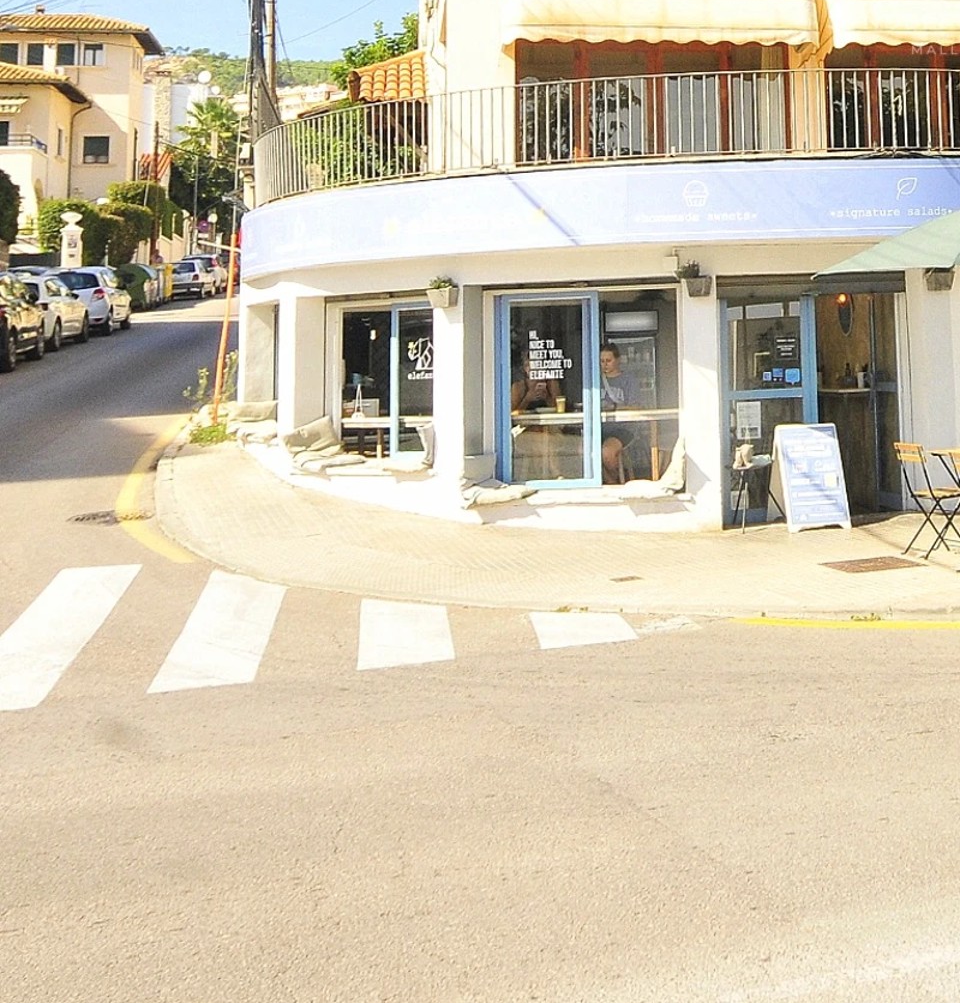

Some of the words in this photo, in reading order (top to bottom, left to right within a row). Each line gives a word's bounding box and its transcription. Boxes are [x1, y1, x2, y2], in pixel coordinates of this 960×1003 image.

[529, 340, 545, 350] NICE
[546, 339, 555, 349] TO
[529, 349, 547, 360] MEET
[529, 359, 562, 370] WELCOME
[563, 358, 573, 369] TO
[529, 369, 565, 380] ELEFANTE
